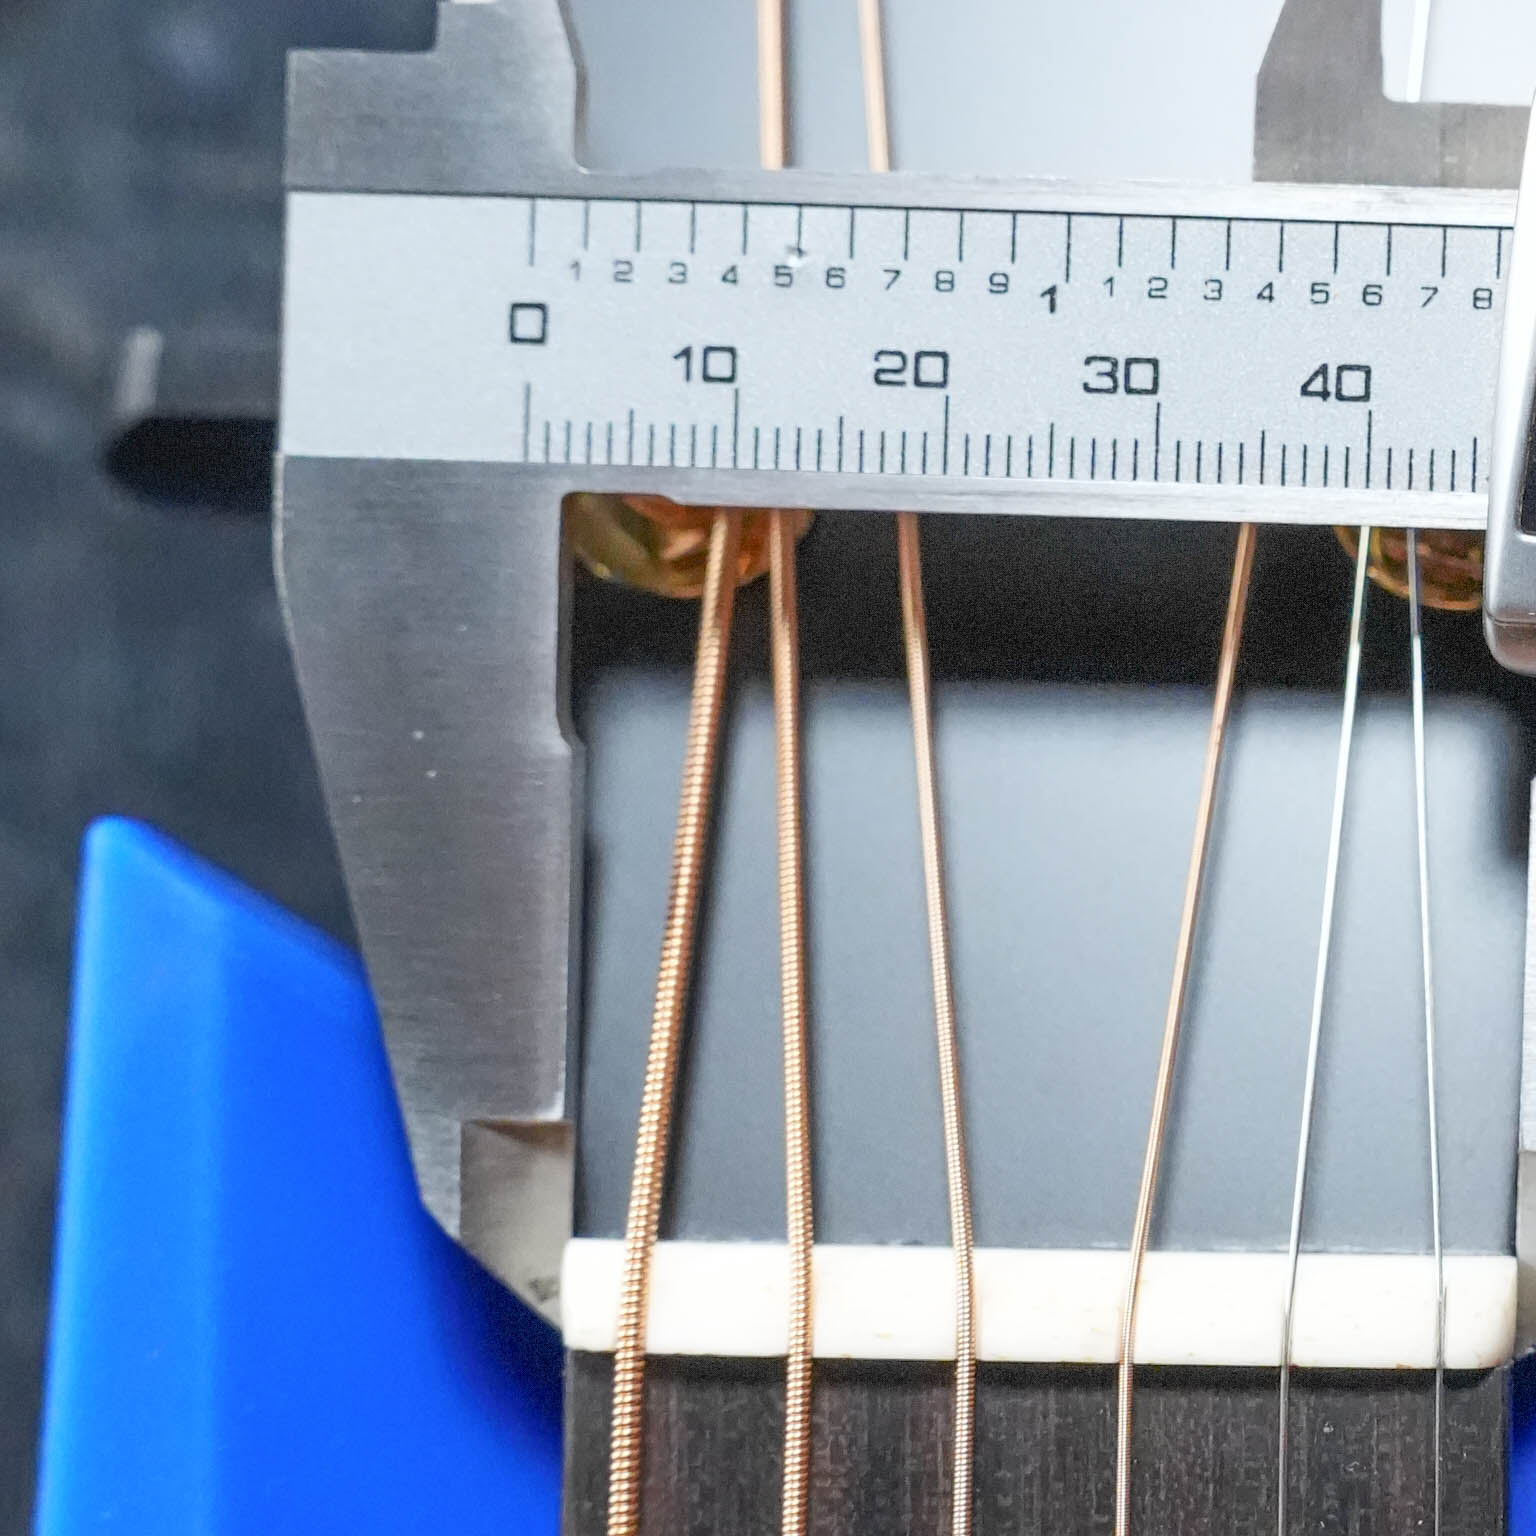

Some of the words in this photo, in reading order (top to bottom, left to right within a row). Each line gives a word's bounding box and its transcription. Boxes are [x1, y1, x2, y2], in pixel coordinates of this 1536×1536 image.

[569, 262, 581, 281] 1
[612, 260, 634, 283] 2
[667, 263, 689, 285] 3
[721, 266, 740, 286] 4
[773, 266, 794, 288] 5
[825, 268, 847, 289] 6
[883, 270, 902, 291] 7
[935, 271, 956, 293] 8
[988, 273, 1010, 295] 9
[1040, 285, 1058, 314] 1
[1102, 277, 1115, 298] 1
[1147, 277, 1168, 300] 2
[1203, 279, 1224, 301] 3
[1257, 282, 1275, 303] 4
[1310, 282, 1330, 305] 5
[1362, 285, 1384, 307] 6
[1420, 287, 1439, 308] 7
[1472, 288, 1494, 311] 8
[510, 302, 548, 344] 0
[673, 345, 737, 383] 10
[873, 350, 949, 389] 20
[1082, 356, 1159, 396] 30
[1300, 363, 1372, 402] 40
